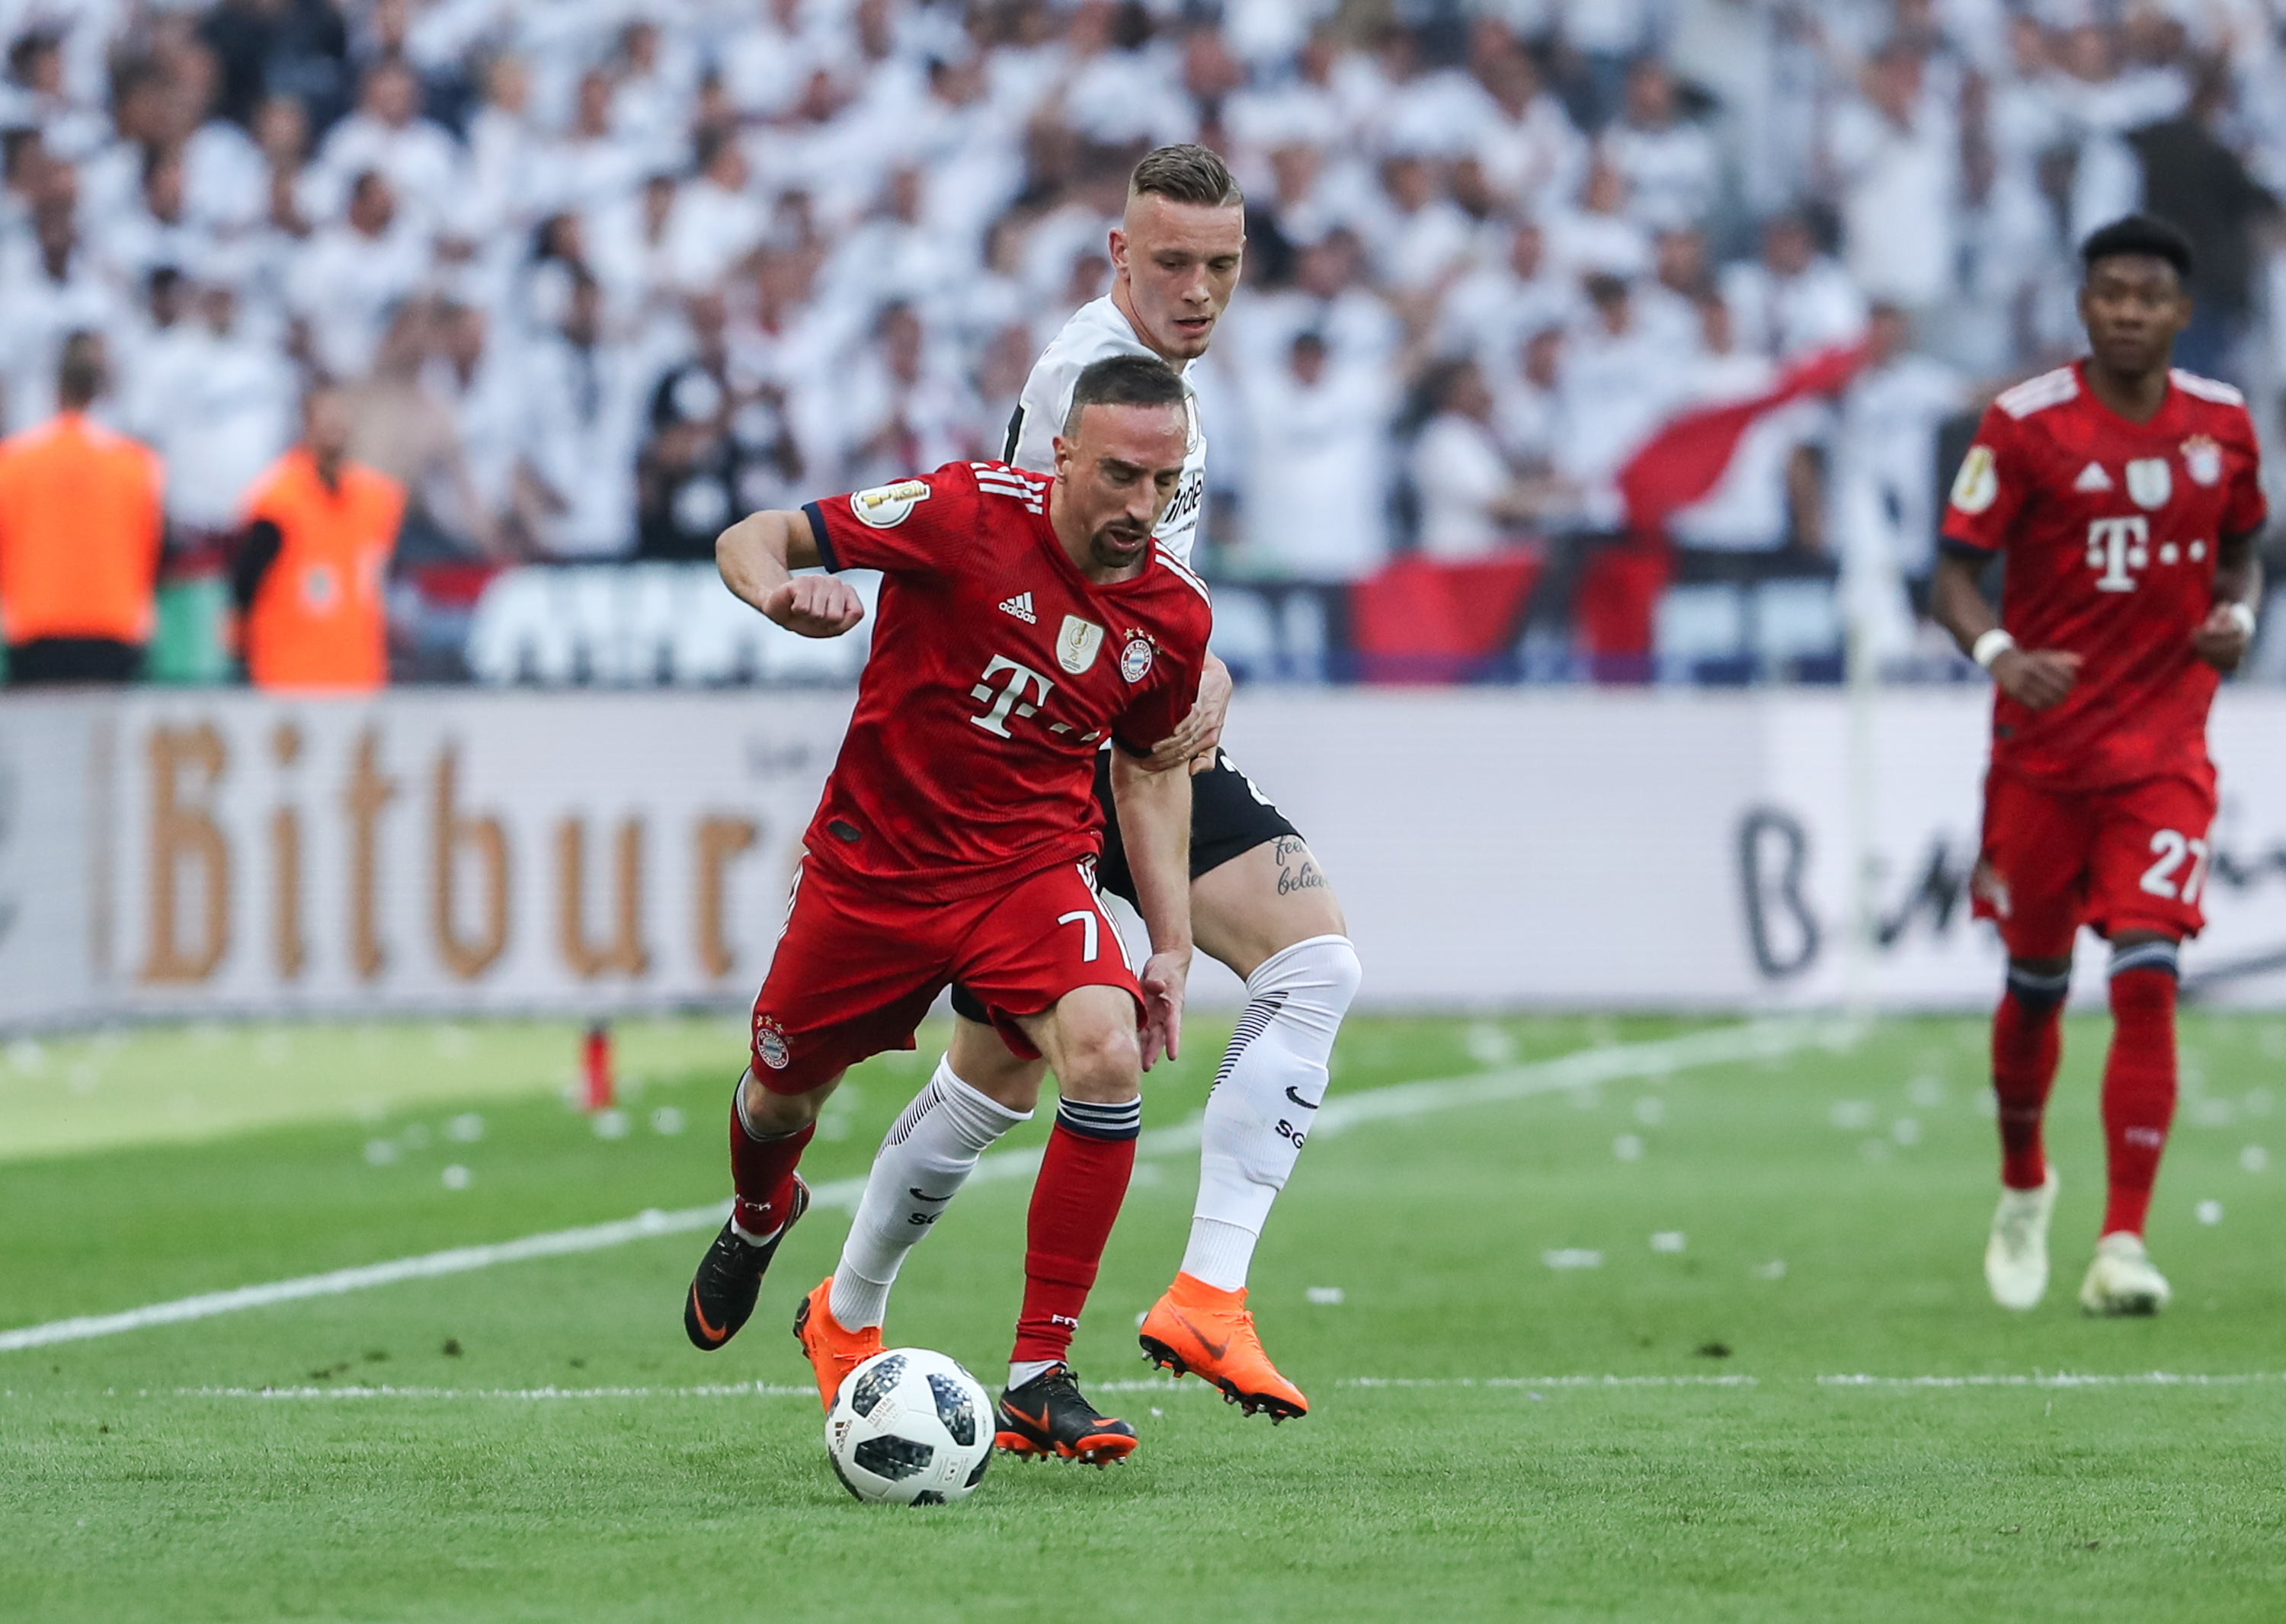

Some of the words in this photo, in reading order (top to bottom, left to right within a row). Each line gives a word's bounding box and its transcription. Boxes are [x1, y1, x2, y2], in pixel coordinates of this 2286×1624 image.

[998, 601, 1037, 625] adidas
[1278, 862, 1329, 895] believ
[2139, 828, 2209, 905] 27
[1057, 910, 1097, 963] 7
[1275, 1118, 1306, 1149] SG
[867, 1396, 892, 1425] TELSTRA
